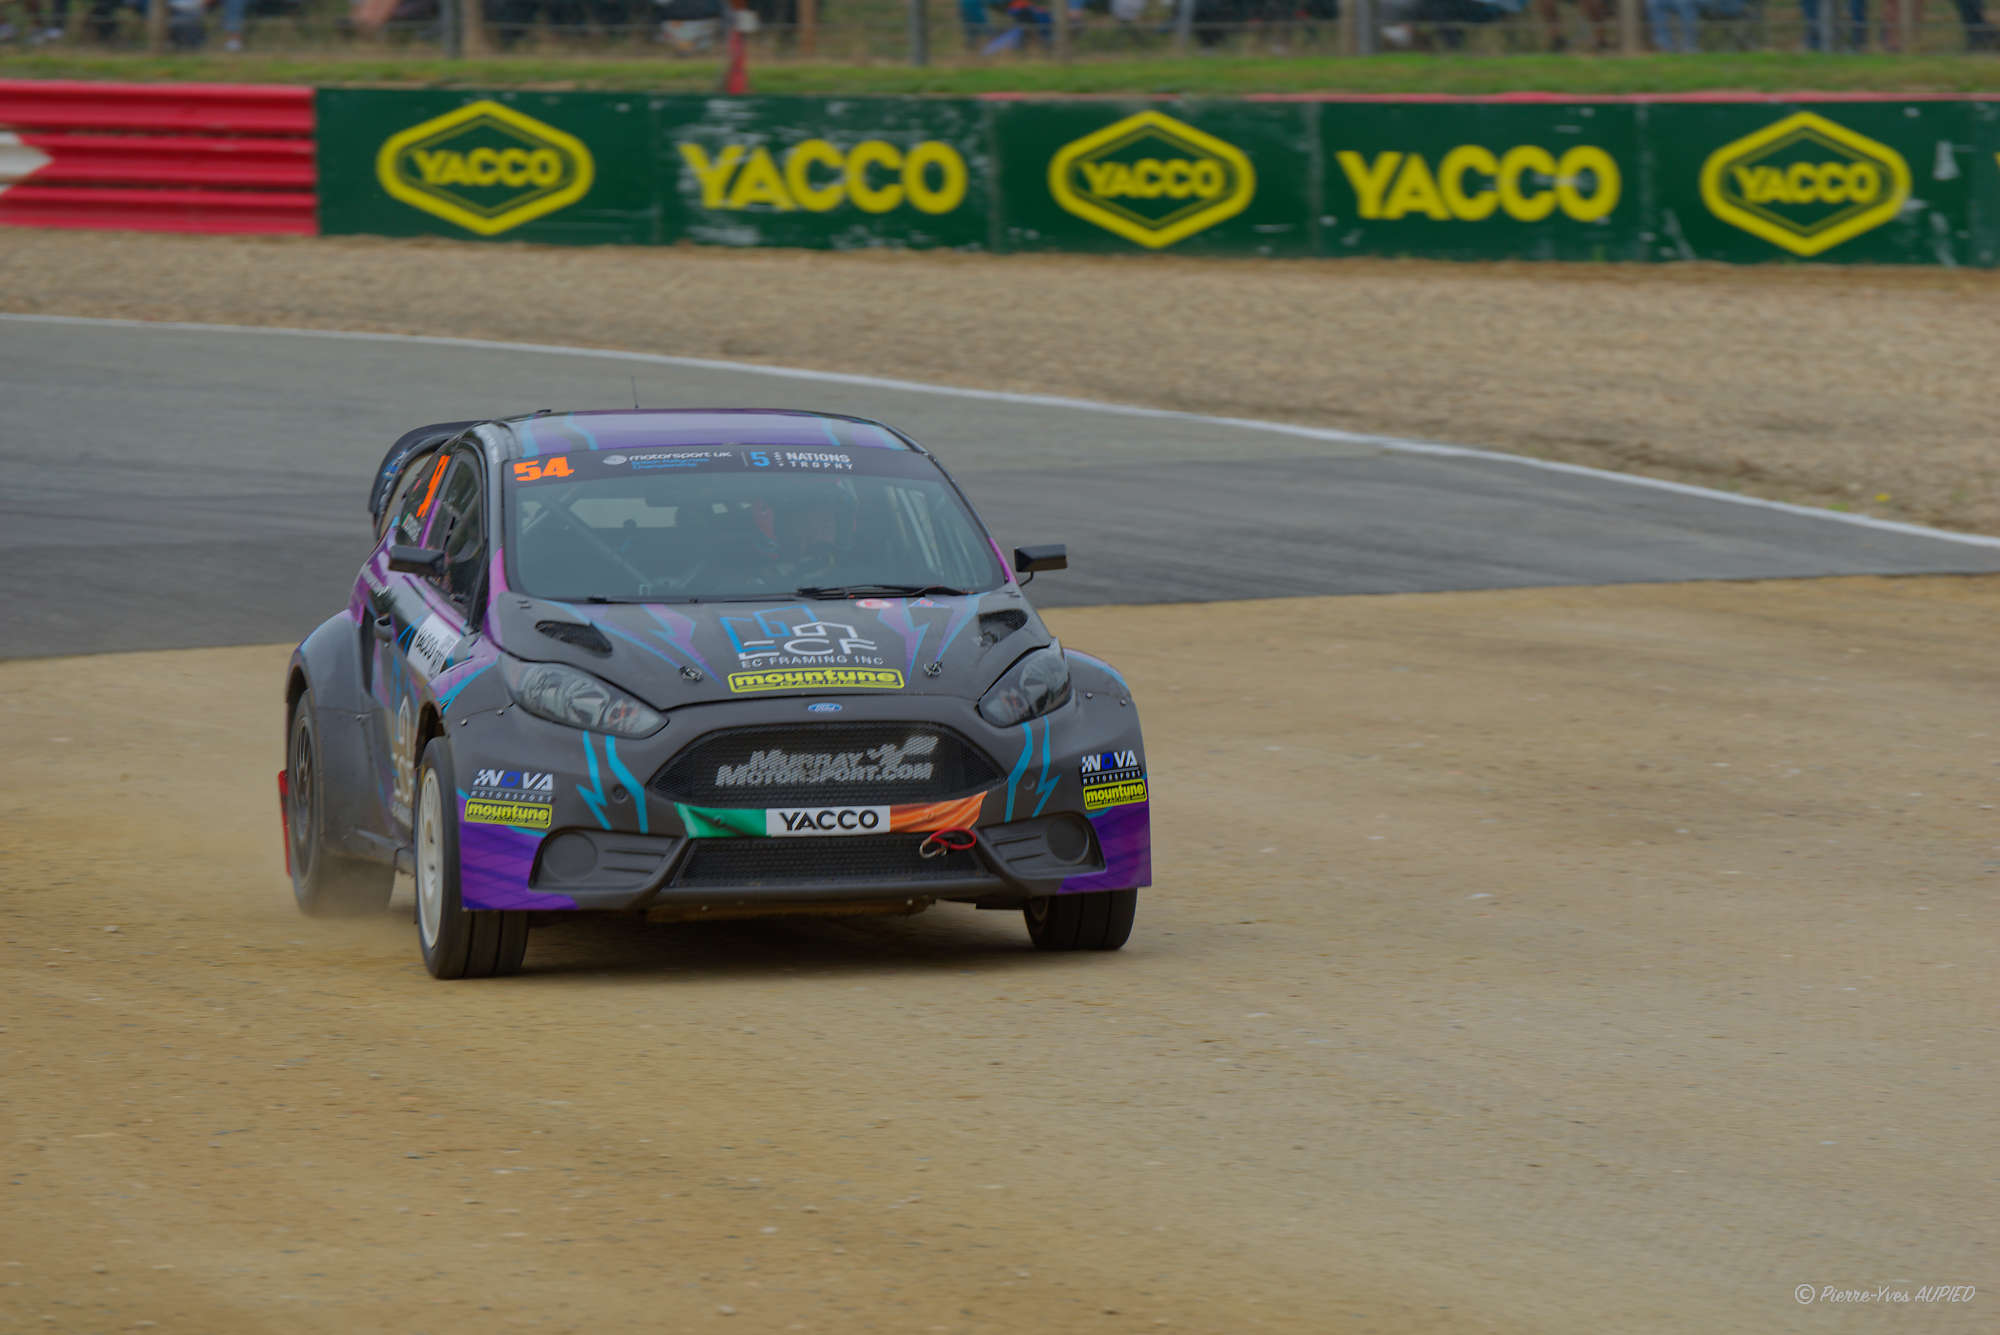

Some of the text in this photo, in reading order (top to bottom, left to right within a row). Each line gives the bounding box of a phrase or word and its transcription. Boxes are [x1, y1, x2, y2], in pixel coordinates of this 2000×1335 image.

[411, 147, 562, 187] YACCO
[679, 139, 968, 214] YACCO
[1081, 159, 1226, 199] YACCO
[1336, 144, 1621, 221] YACCO
[1733, 161, 1880, 203] YACCO
[629, 451, 712, 462] motorsport
[750, 451, 770, 467] 5
[785, 452, 851, 463] NATIONS
[790, 460, 854, 470] TROPHY
[513, 456, 575, 482] 54
[741, 655, 884, 668] EC FRAMING INC
[735, 669, 896, 687] mountune
[1081, 750, 1138, 773] NOVA
[473, 768, 553, 791] NOVA
[1086, 783, 1144, 802] mountune
[467, 802, 549, 821] mountune
[779, 809, 879, 831] YACCO
